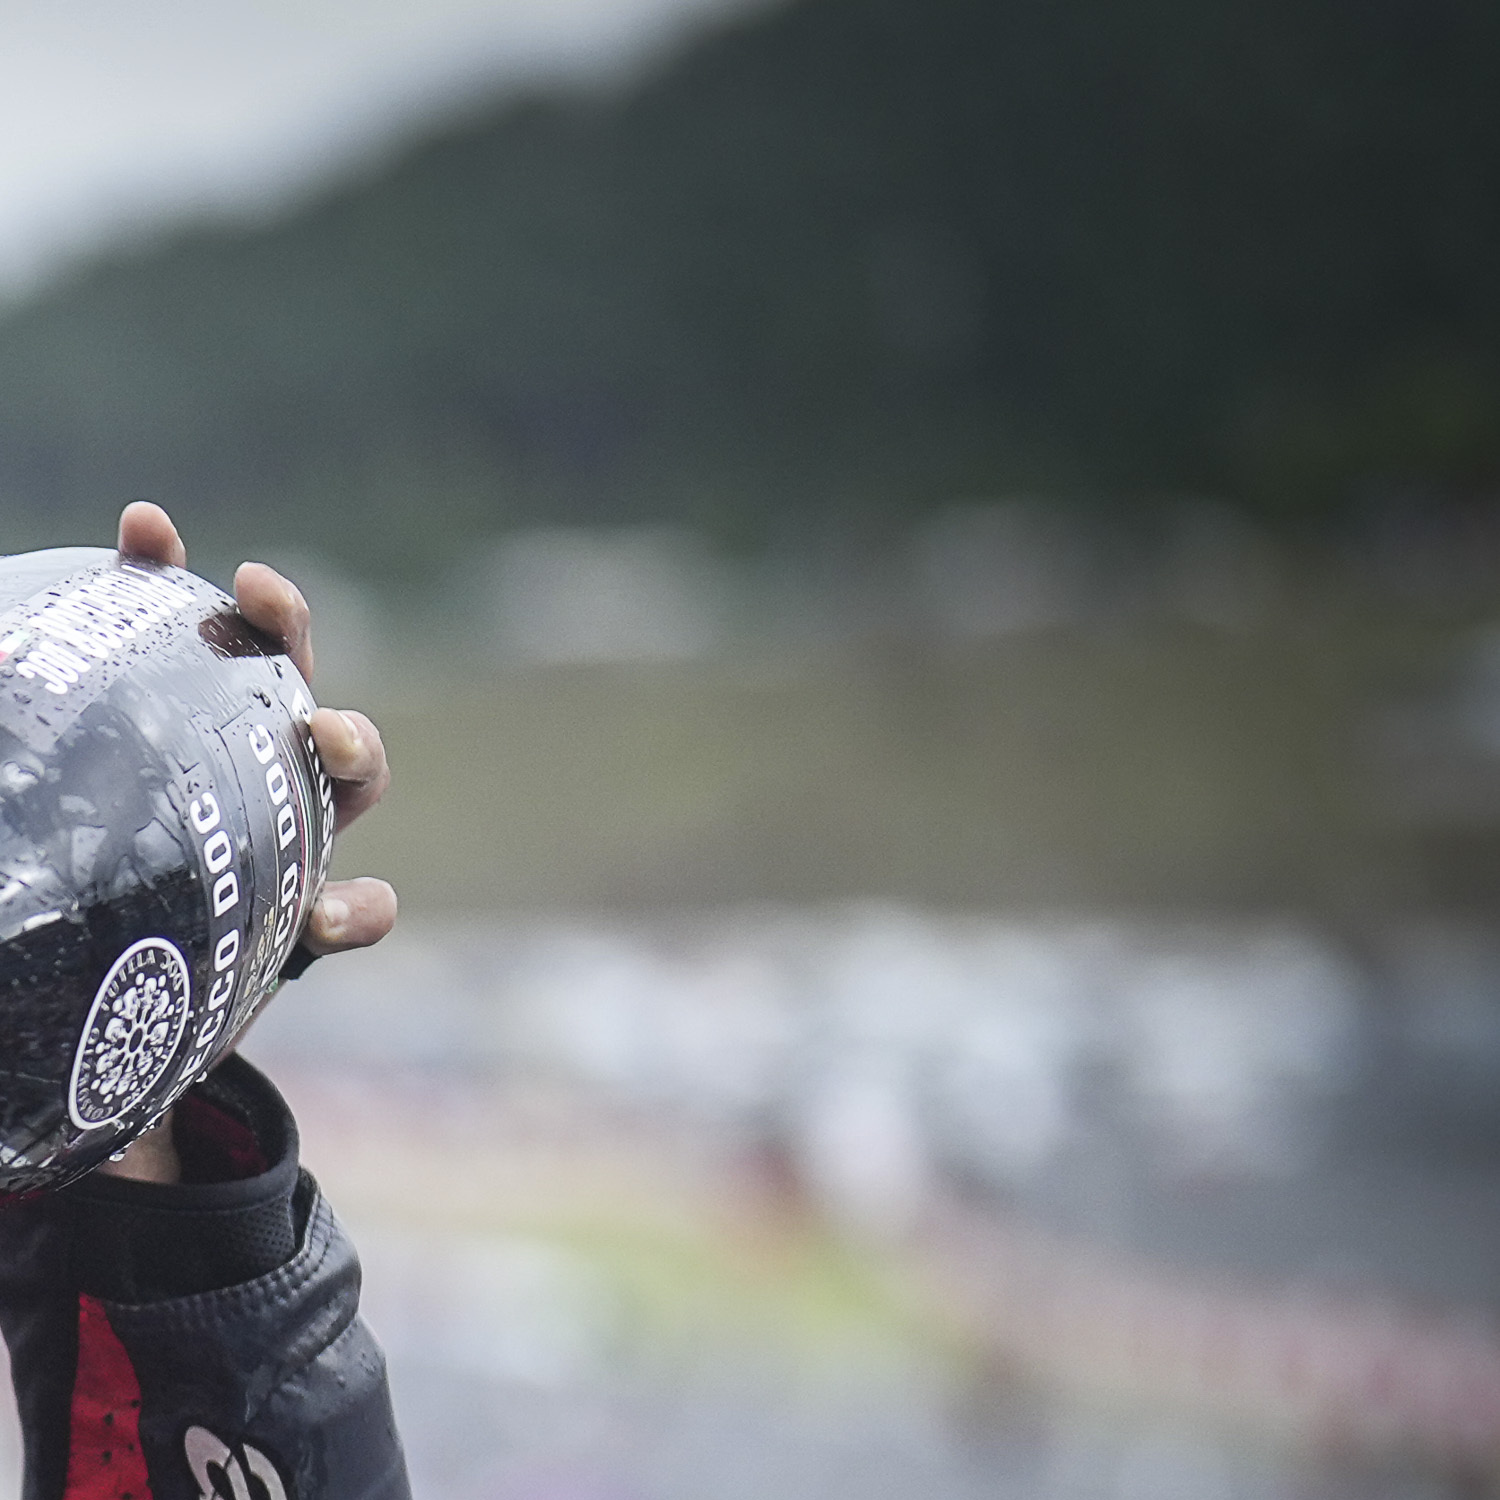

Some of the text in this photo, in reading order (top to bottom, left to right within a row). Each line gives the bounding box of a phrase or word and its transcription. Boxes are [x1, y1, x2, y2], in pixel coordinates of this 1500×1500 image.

[15, 640, 92, 695] DOC
[248, 723, 298, 851] DOC
[189, 791, 240, 918] DOC
